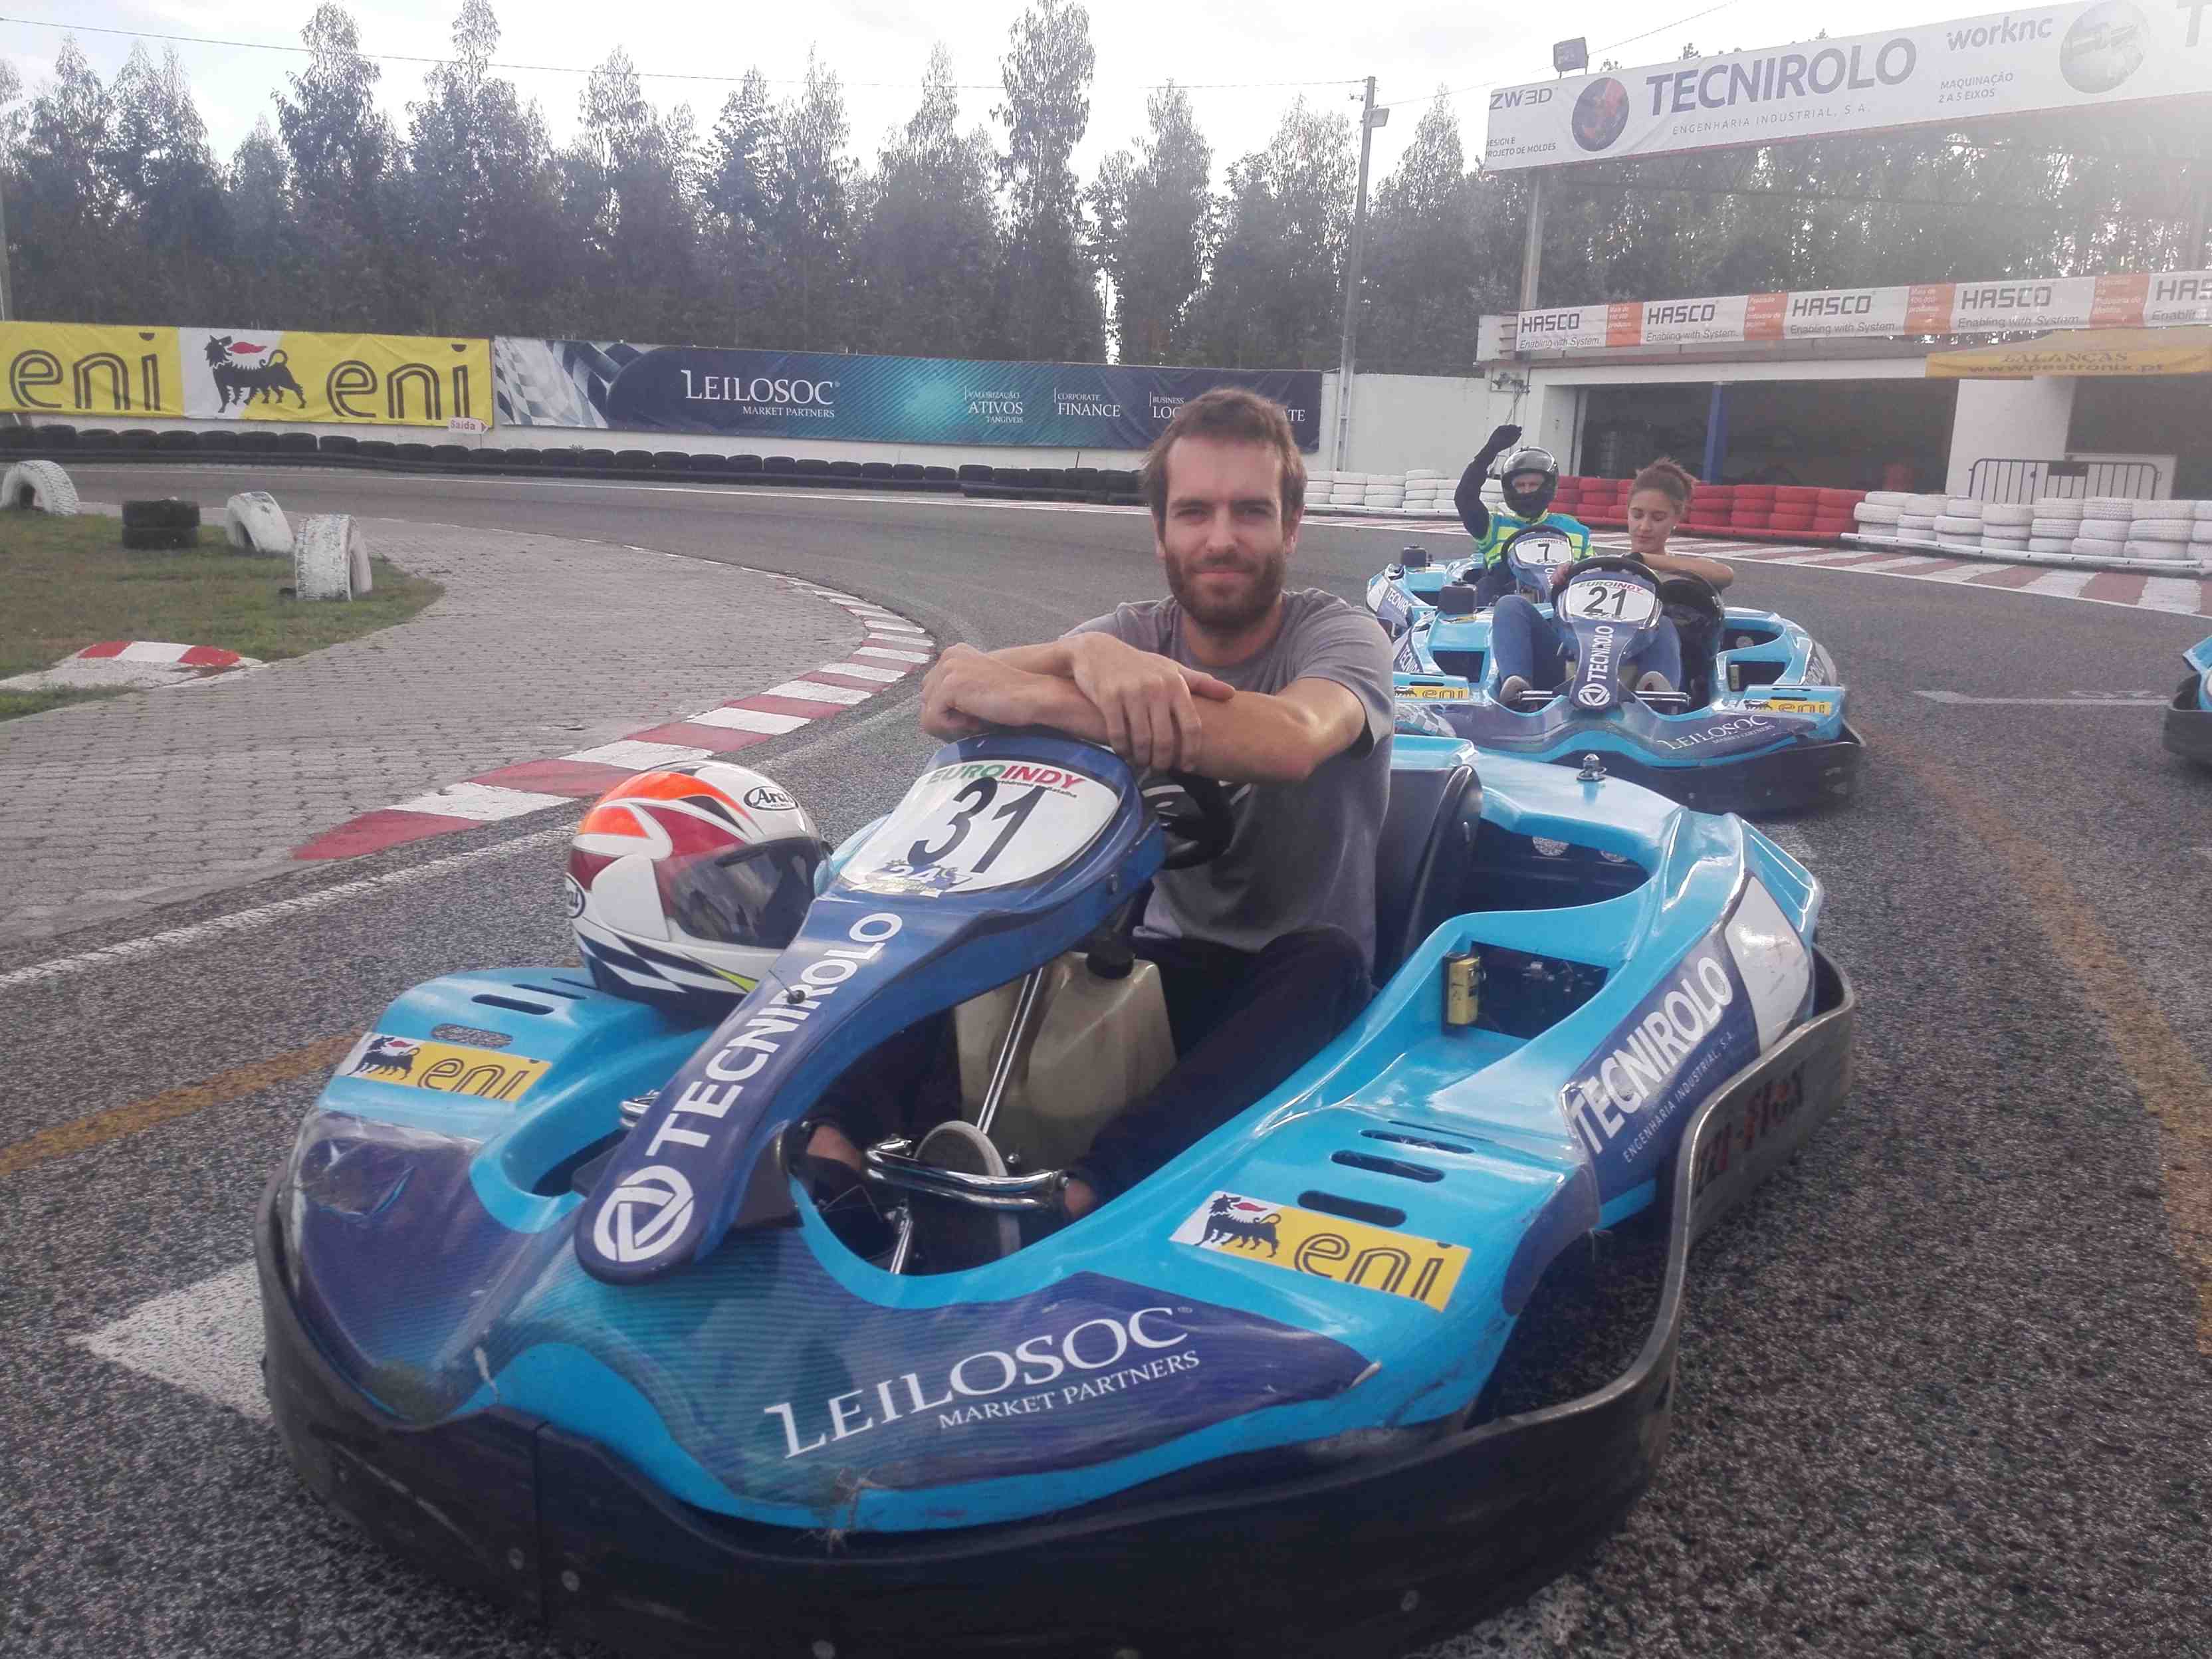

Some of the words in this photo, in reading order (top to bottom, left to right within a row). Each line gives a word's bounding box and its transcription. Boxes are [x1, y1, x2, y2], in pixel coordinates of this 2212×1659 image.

[1946, 17, 2052, 51] worknc
[1646, 37, 1917, 116] TECNIROLO
[1940, 72, 2013, 90] MAQUINAÇÃO
[1489, 88, 1553, 110] ZW3D
[1965, 89, 1995, 100] EIXOS
[1672, 118, 1750, 135] ENGENHARIA
[1527, 143, 1556, 153] MOLDES
[1793, 296, 1871, 316] HASCO
[1962, 286, 2051, 309] HASCO
[1521, 313, 1580, 333] HASCO
[1647, 304, 1715, 324] HASCO
[1959, 317, 2005, 328] Enabling
[2009, 316, 2031, 324] with
[1646, 332, 1680, 342] Enabling
[1682, 330, 1700, 338] with
[1790, 324, 1831, 334] Enabling
[1834, 323, 1854, 332] with
[1520, 339, 1552, 350] Enabling
[10, 332, 160, 411] eni
[326, 344, 471, 419] eni
[681, 370, 835, 405] LEILOSOC
[1057, 393, 1101, 401] CORPORATE
[742, 406, 783, 416] MARKET
[786, 407, 835, 419] PARTNERS
[968, 401, 1024, 415] ATIVOS
[1057, 402, 1121, 417] FINANCE
[1537, 543, 1550, 561] 7
[1579, 581, 1644, 593] EUROINDY
[1583, 586, 1627, 615] 21
[1657, 714, 1768, 750] LEILOSOC
[926, 764, 1086, 790] EUROINDY
[907, 777, 1048, 873] 31
[645, 913, 903, 1157] TECNIROLO
[1568, 957, 1733, 1155] TECNIROLO
[417, 1058, 540, 1100] eni
[1622, 1101, 1676, 1162] ENGENHARIA
[1293, 1232, 1453, 1302] eni
[764, 1307, 1188, 1459] LEILOSOC
[937, 1391, 1055, 1430] MARKET
[1063, 1350, 1200, 1404] PARTNERS
